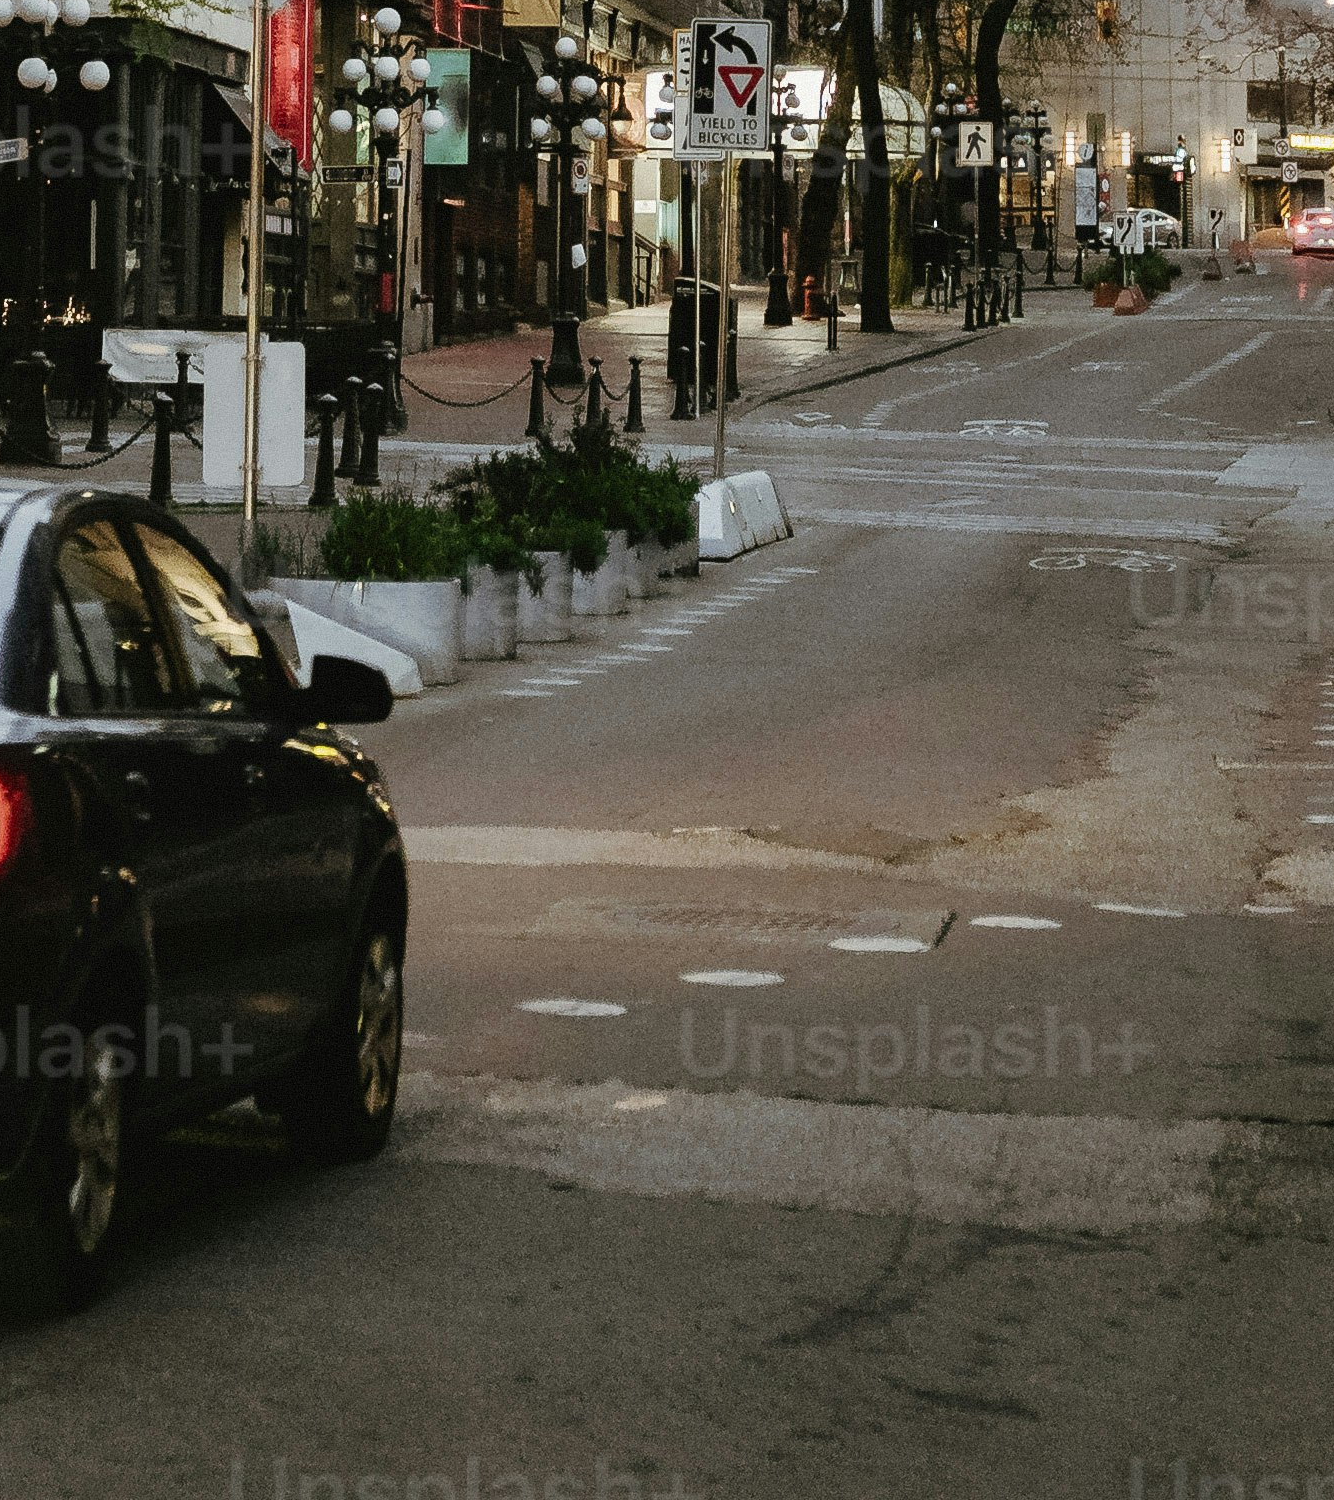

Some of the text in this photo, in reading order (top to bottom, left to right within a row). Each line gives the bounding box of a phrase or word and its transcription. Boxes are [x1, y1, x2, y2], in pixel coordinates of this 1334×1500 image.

[700, 117, 758, 131] YIELD TO
[698, 132, 758, 145] BICYCLES
